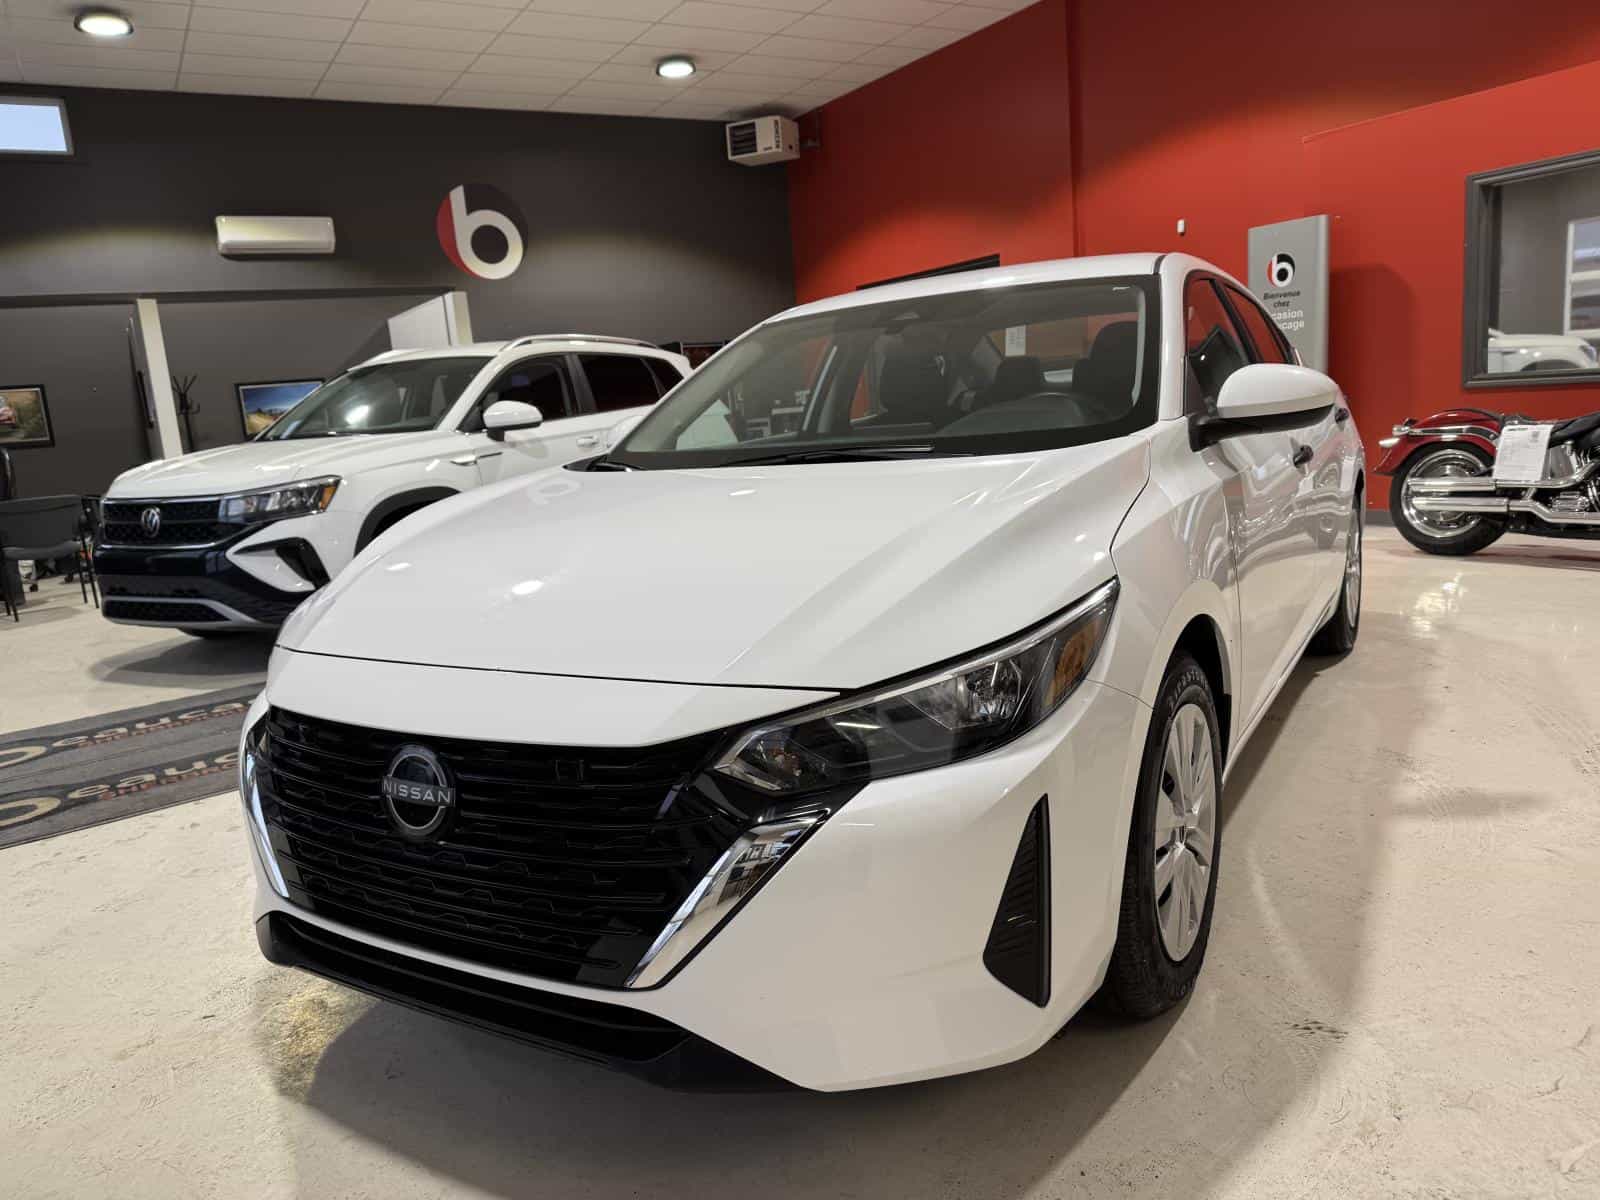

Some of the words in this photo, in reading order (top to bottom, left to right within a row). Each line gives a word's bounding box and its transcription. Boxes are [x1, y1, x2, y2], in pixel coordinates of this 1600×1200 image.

[1273, 300, 1290, 308] chez
[1271, 309, 1304, 320] casion
[1281, 320, 1305, 331] cage
[384, 779, 451, 803] NISSAN
